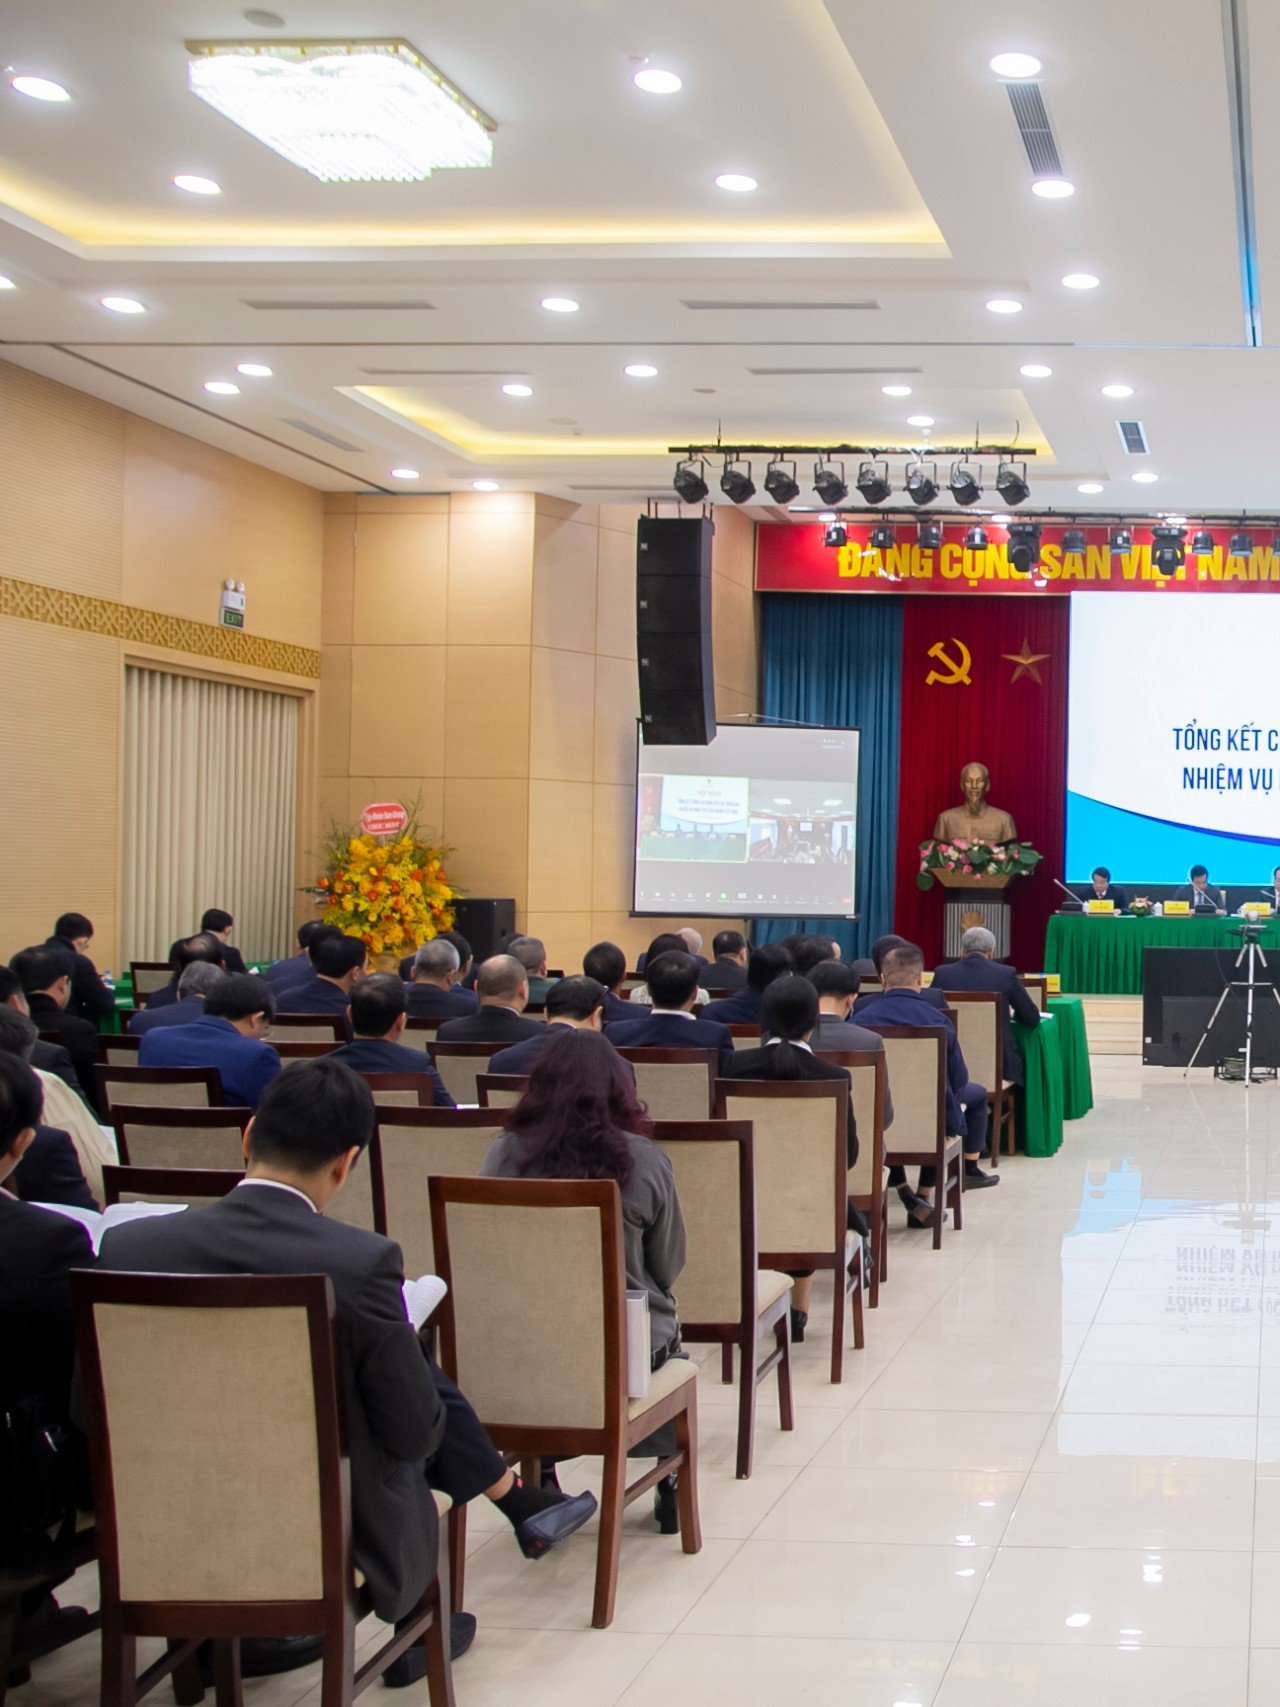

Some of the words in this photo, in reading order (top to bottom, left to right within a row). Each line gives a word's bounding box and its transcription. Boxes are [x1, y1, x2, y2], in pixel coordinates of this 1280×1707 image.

[1173, 718, 1221, 751] TỔNG
[1227, 722, 1262, 752] KẾT
[1183, 763, 1243, 795] NHIỆM
[1249, 768, 1273, 796] VỤ
